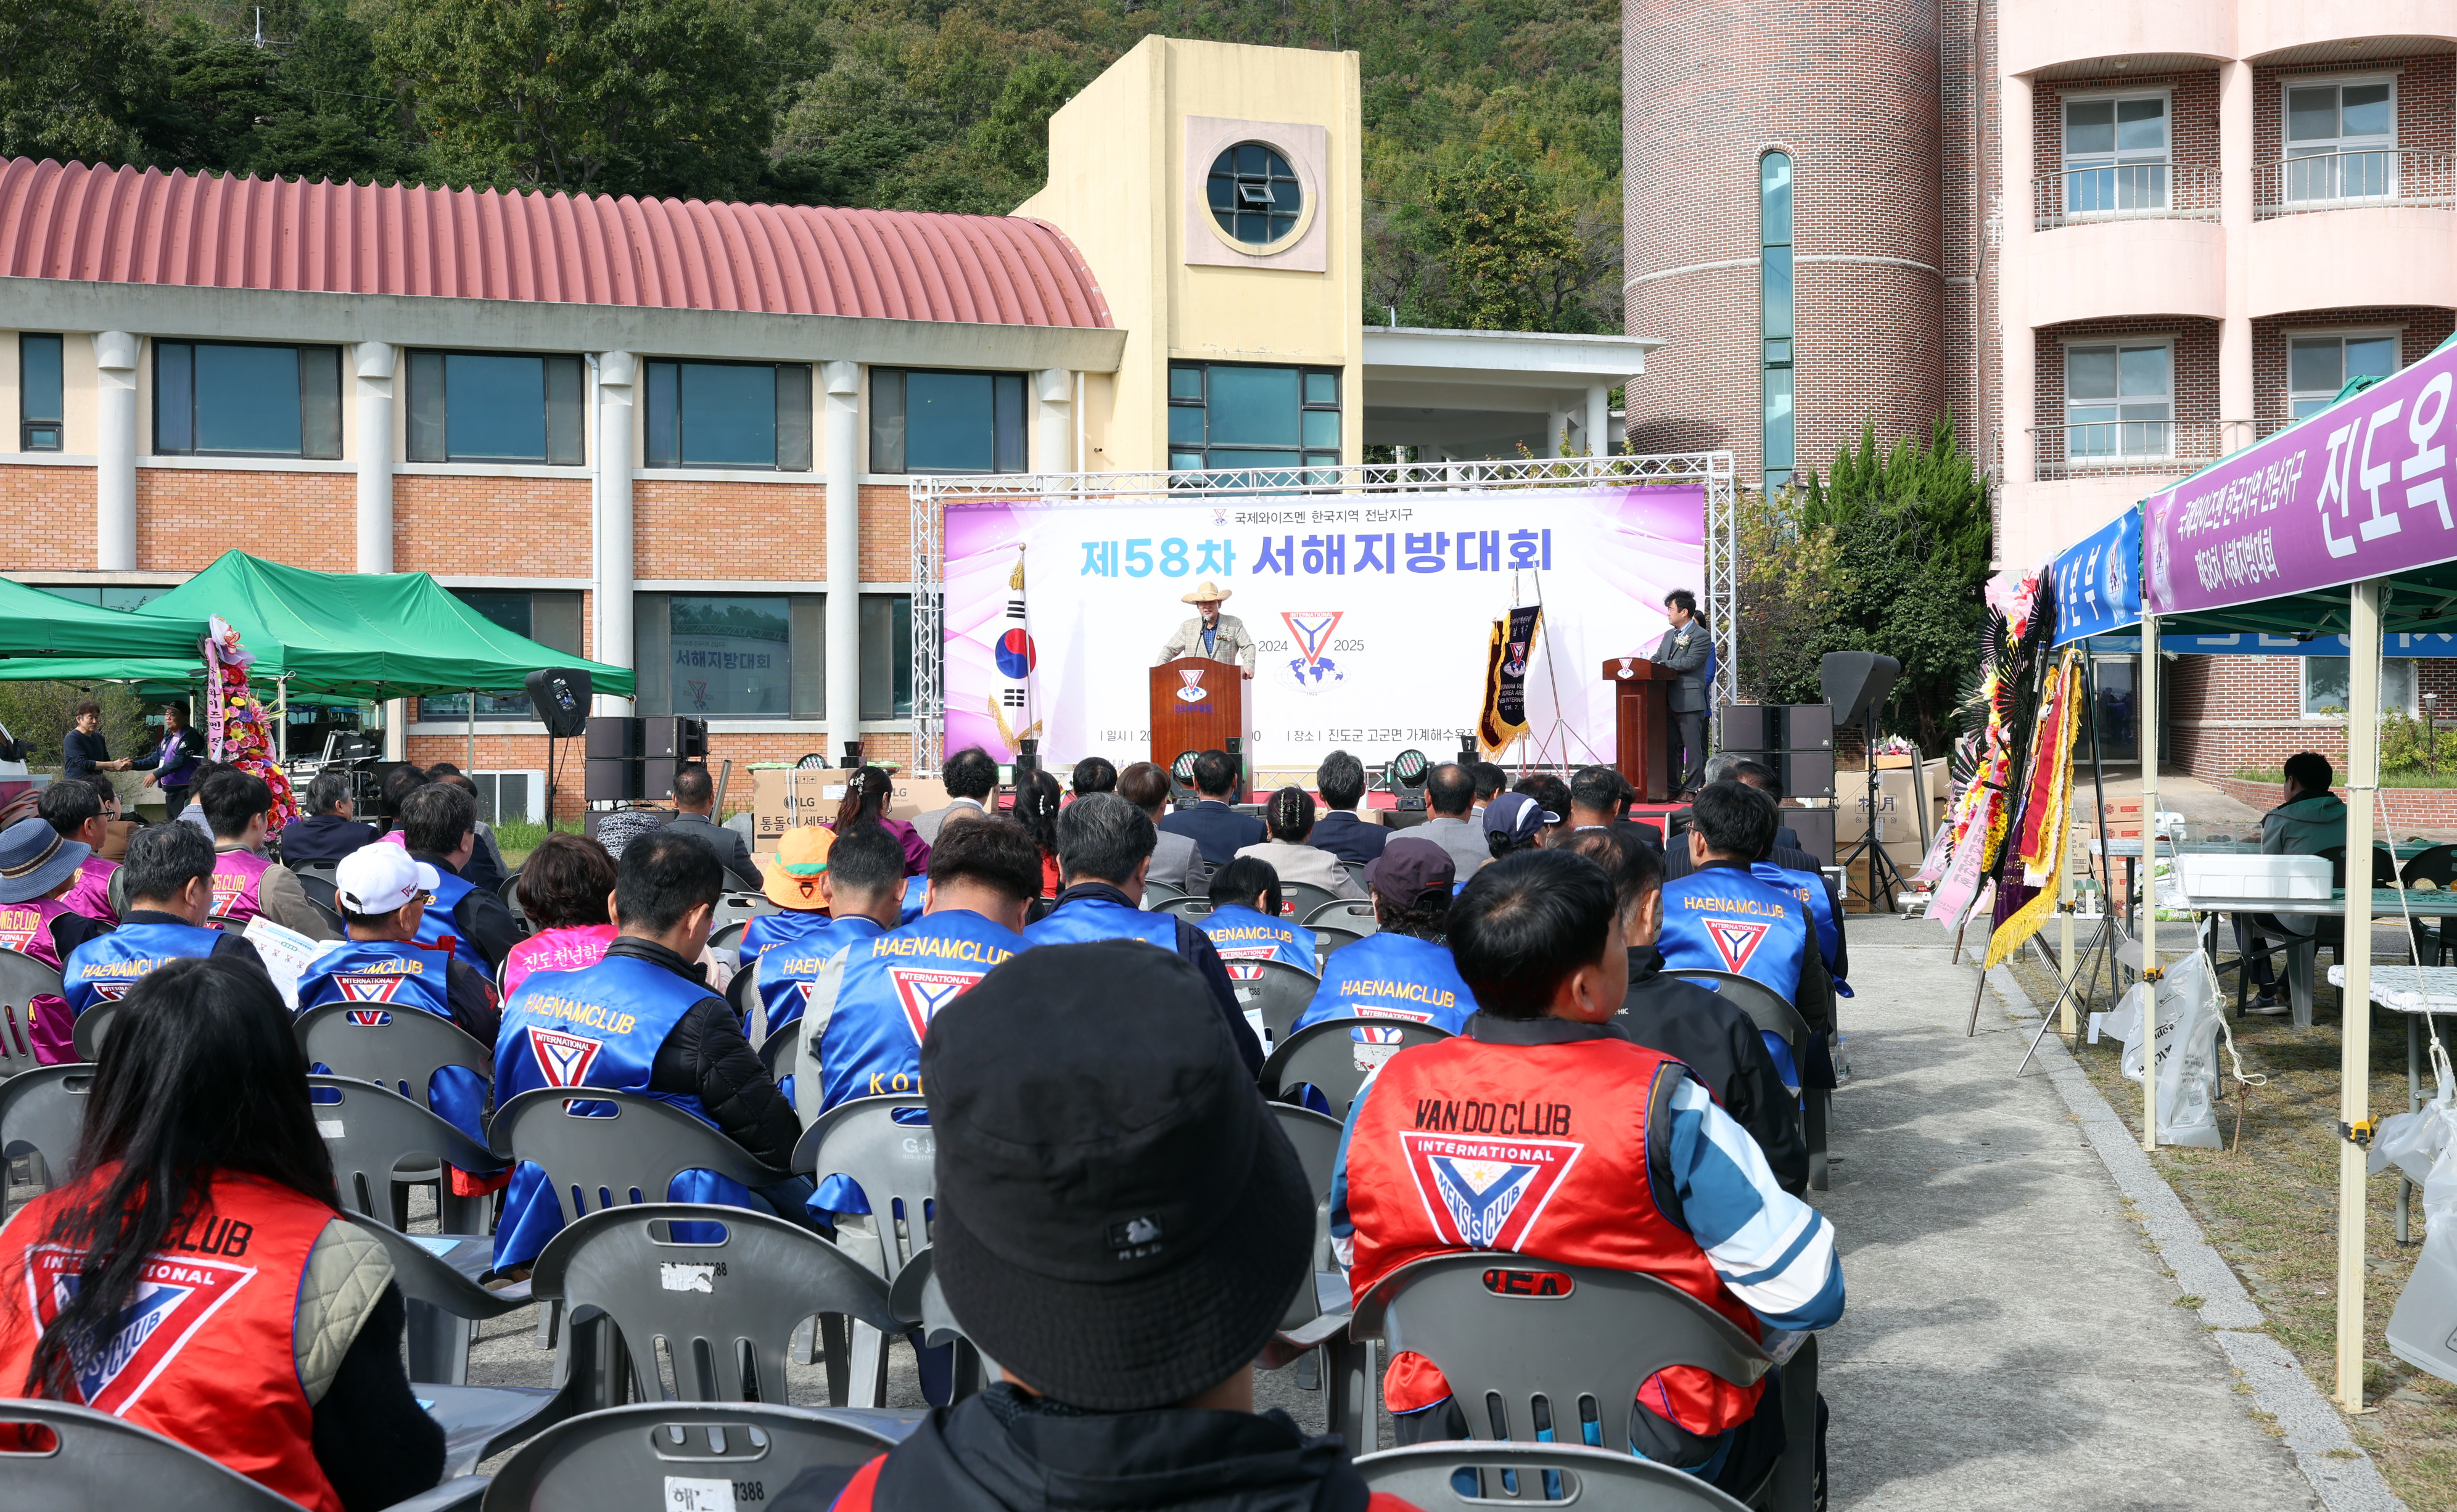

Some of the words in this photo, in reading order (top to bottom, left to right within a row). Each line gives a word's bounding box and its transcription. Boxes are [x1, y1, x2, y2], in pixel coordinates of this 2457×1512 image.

[2316, 371, 2457, 558] 진도옥
[2178, 483, 2229, 541] 국제와이즈멘
[2223, 466, 2265, 526] 한국지역
[2261, 449, 2307, 512] 전남지구
[1235, 511, 1306, 524] 국제와이즈멘
[1312, 509, 1359, 523] 한국지역
[1365, 509, 1414, 522] 전남지구
[1081, 537, 1236, 578] 제58차
[1253, 528, 1551, 575] 서해지방대회
[2195, 544, 2226, 593] 제58차
[2221, 527, 2279, 587] 서해지방대회
[1258, 640, 1288, 652] 2024
[1334, 639, 1364, 651] 2025
[676, 650, 770, 669] 서해지방대회
[1328, 728, 1364, 742] 진도군
[1367, 728, 1402, 741] 고군면
[800, 797, 815, 807] LG
[892, 788, 907, 797] LG
[222, 874, 246, 891] CLUB
[1684, 897, 1785, 919] HAENAMCLUB
[14, 911, 41, 931] CLUB
[1711, 922, 1762, 932] INTERNATIONAL
[1204, 927, 1293, 943] AENAMCLUB
[783, 958, 826, 975] HAEN
[900, 972, 972, 985] INTERNATIONAL
[1340, 980, 1455, 1008] HAENAMCLUB
[522, 993, 635, 1035] HAENAMCLUB
[536, 1033, 591, 1051] INTERNATIONAL
[870, 1073, 923, 1095] KO
[1463, 1101, 1496, 1133] DO
[1500, 1101, 1571, 1135] CLUB
[1418, 1141, 1554, 1161] INTERNATIONAL
[1439, 1172, 1469, 1236] MEN'S
[1486, 1186, 1520, 1240] CLUB
[108, 1312, 160, 1376] CLUB
[733, 1482, 764, 1502] 7388
